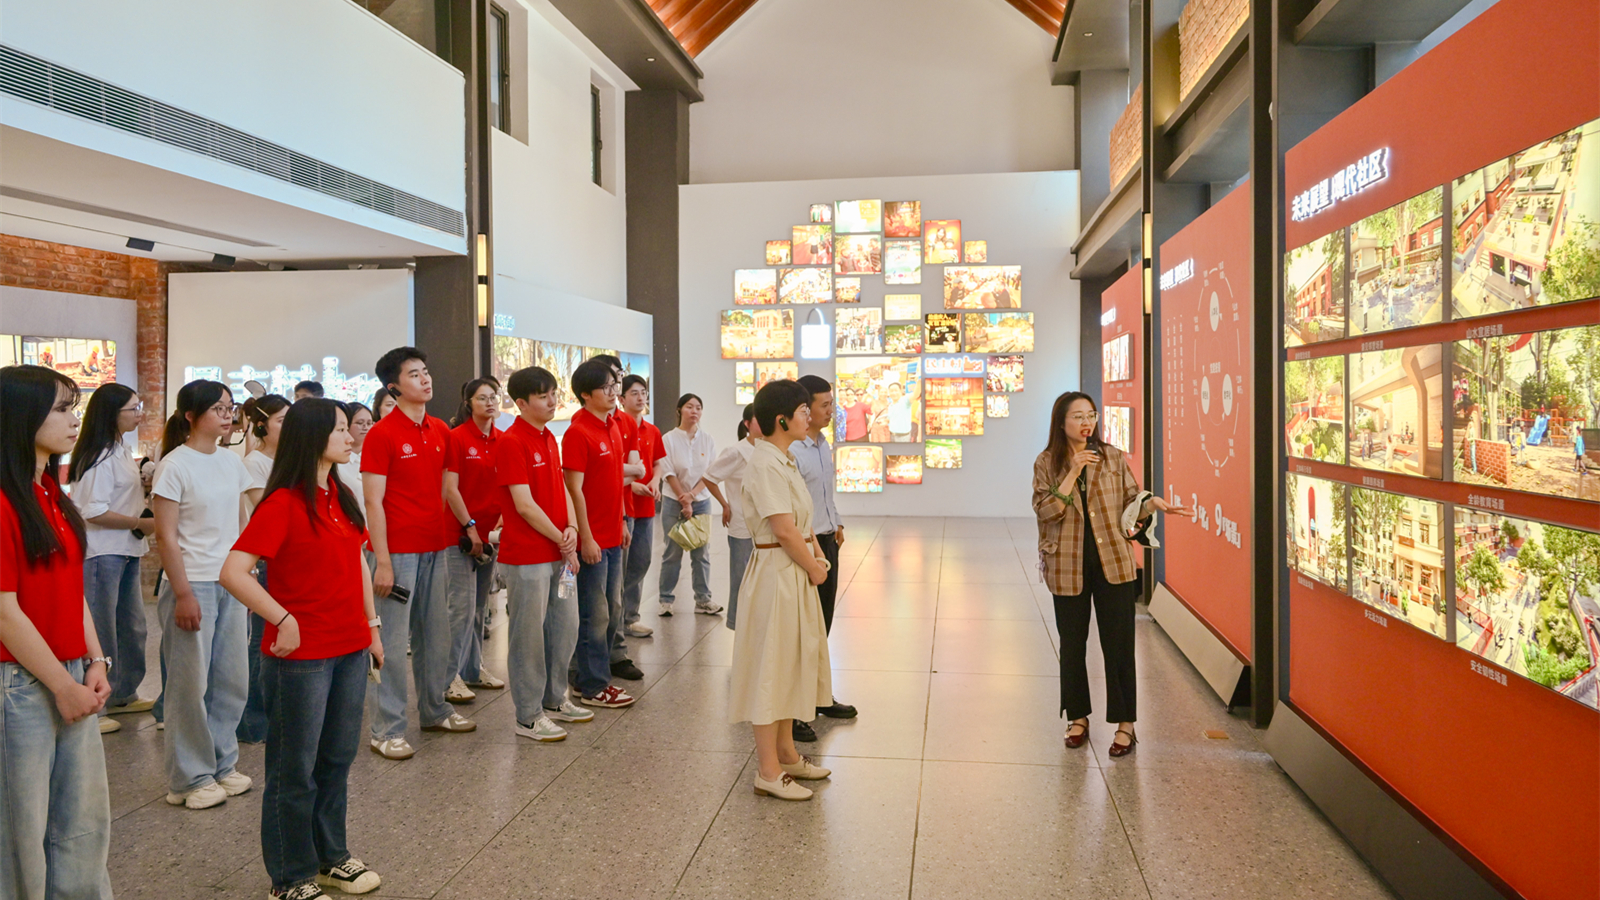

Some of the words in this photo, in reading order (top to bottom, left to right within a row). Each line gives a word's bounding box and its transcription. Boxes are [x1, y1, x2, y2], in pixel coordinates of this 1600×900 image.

[1292, 177, 1331, 222] 未来展望
[1333, 147, 1386, 200] 现代社区
[1466, 323, 1503, 339] 山水宜居场景
[1467, 493, 1505, 511] 全龄教育场景
